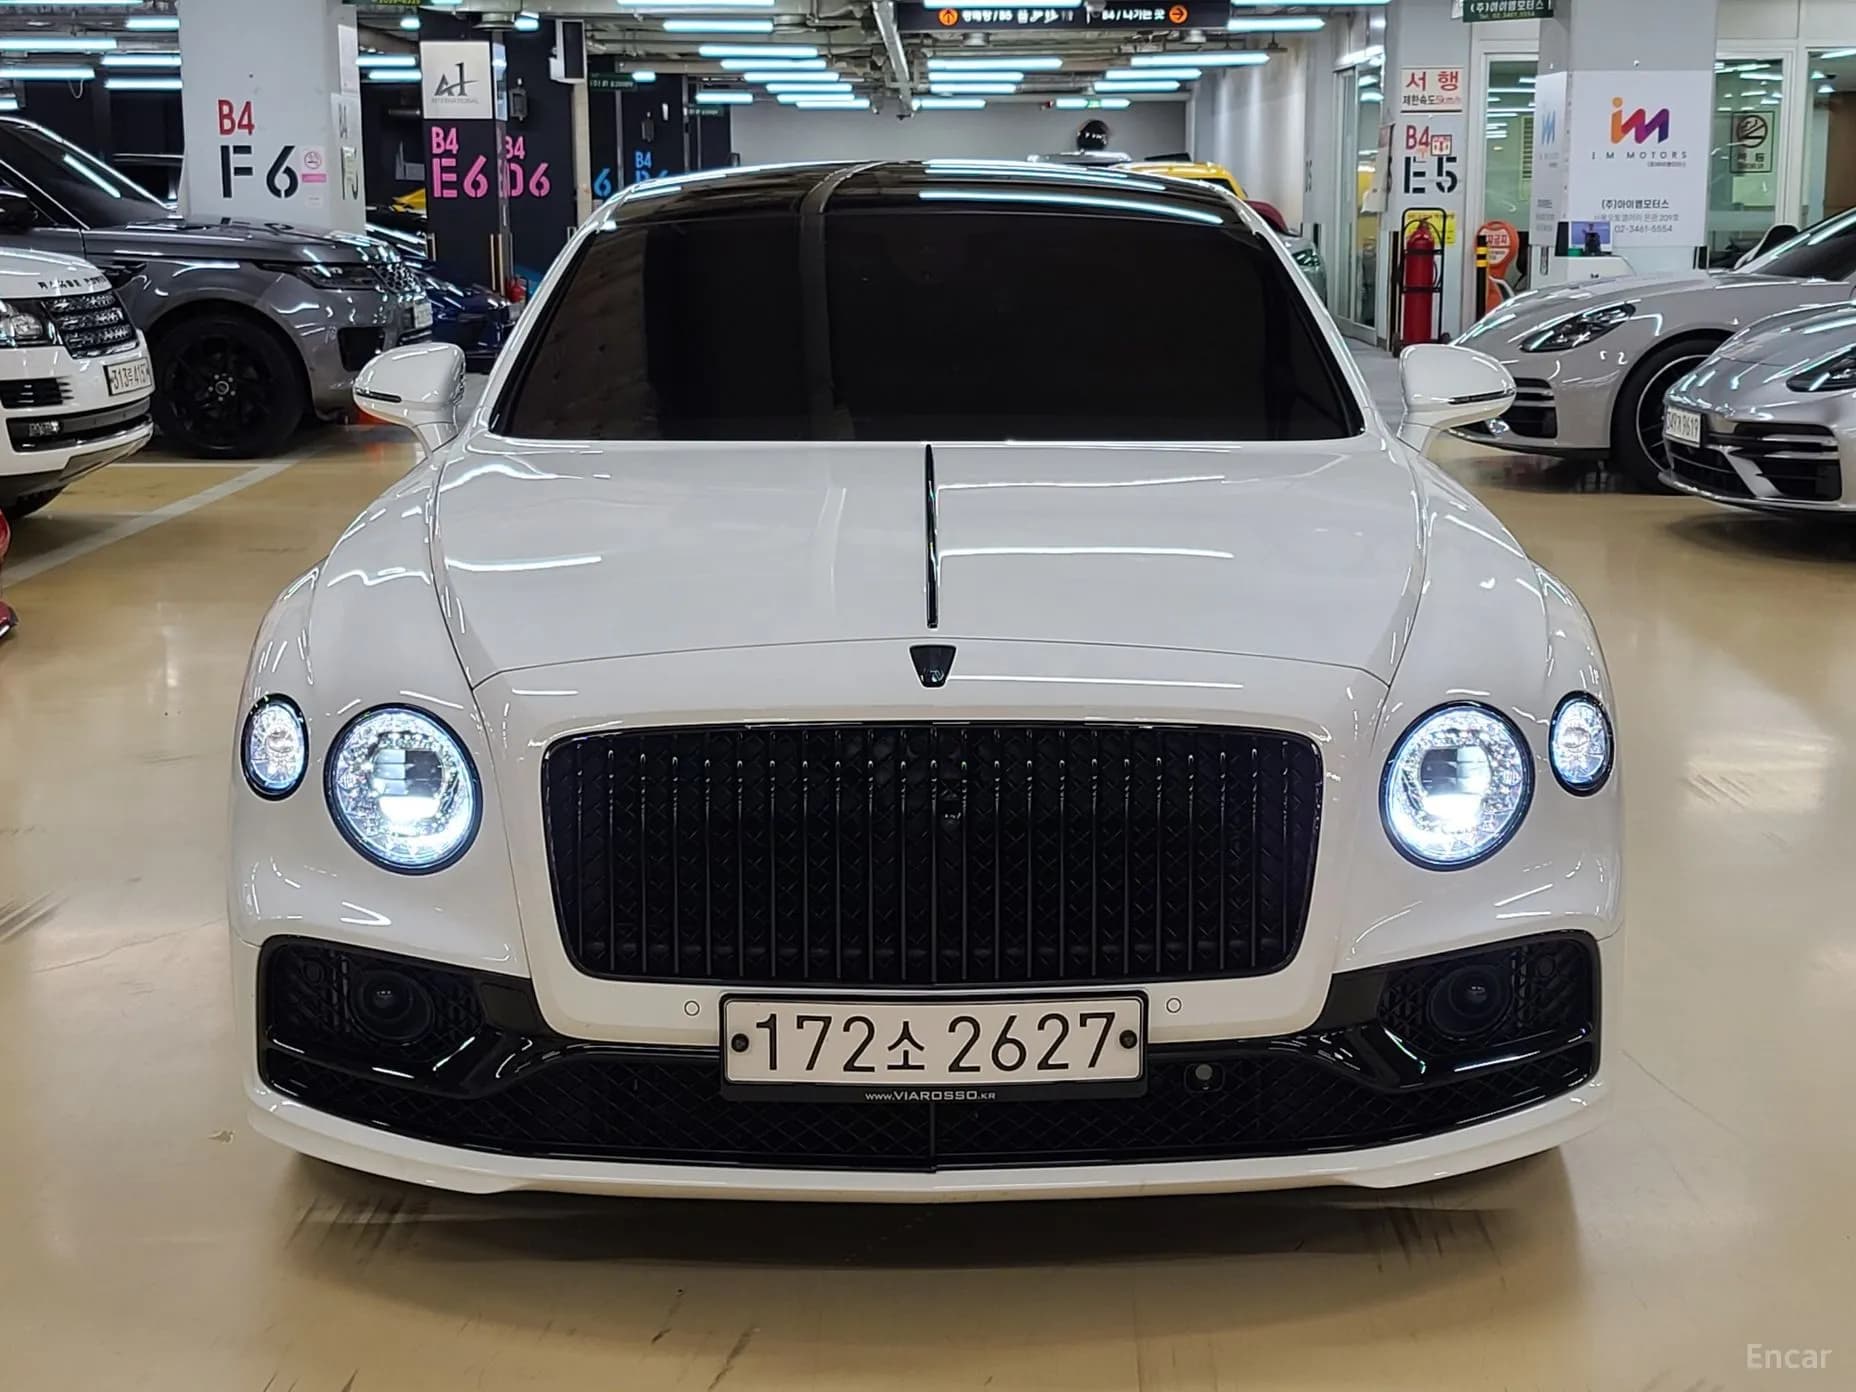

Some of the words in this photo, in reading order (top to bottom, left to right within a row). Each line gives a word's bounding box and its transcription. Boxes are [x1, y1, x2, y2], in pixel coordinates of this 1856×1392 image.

[218, 99, 255, 136] B4
[431, 126, 459, 154] B4
[1406, 124, 1430, 150] B4
[635, 152, 652, 168] B4
[1627, 151, 1687, 159] MOTORS
[432, 155, 489, 198] E6
